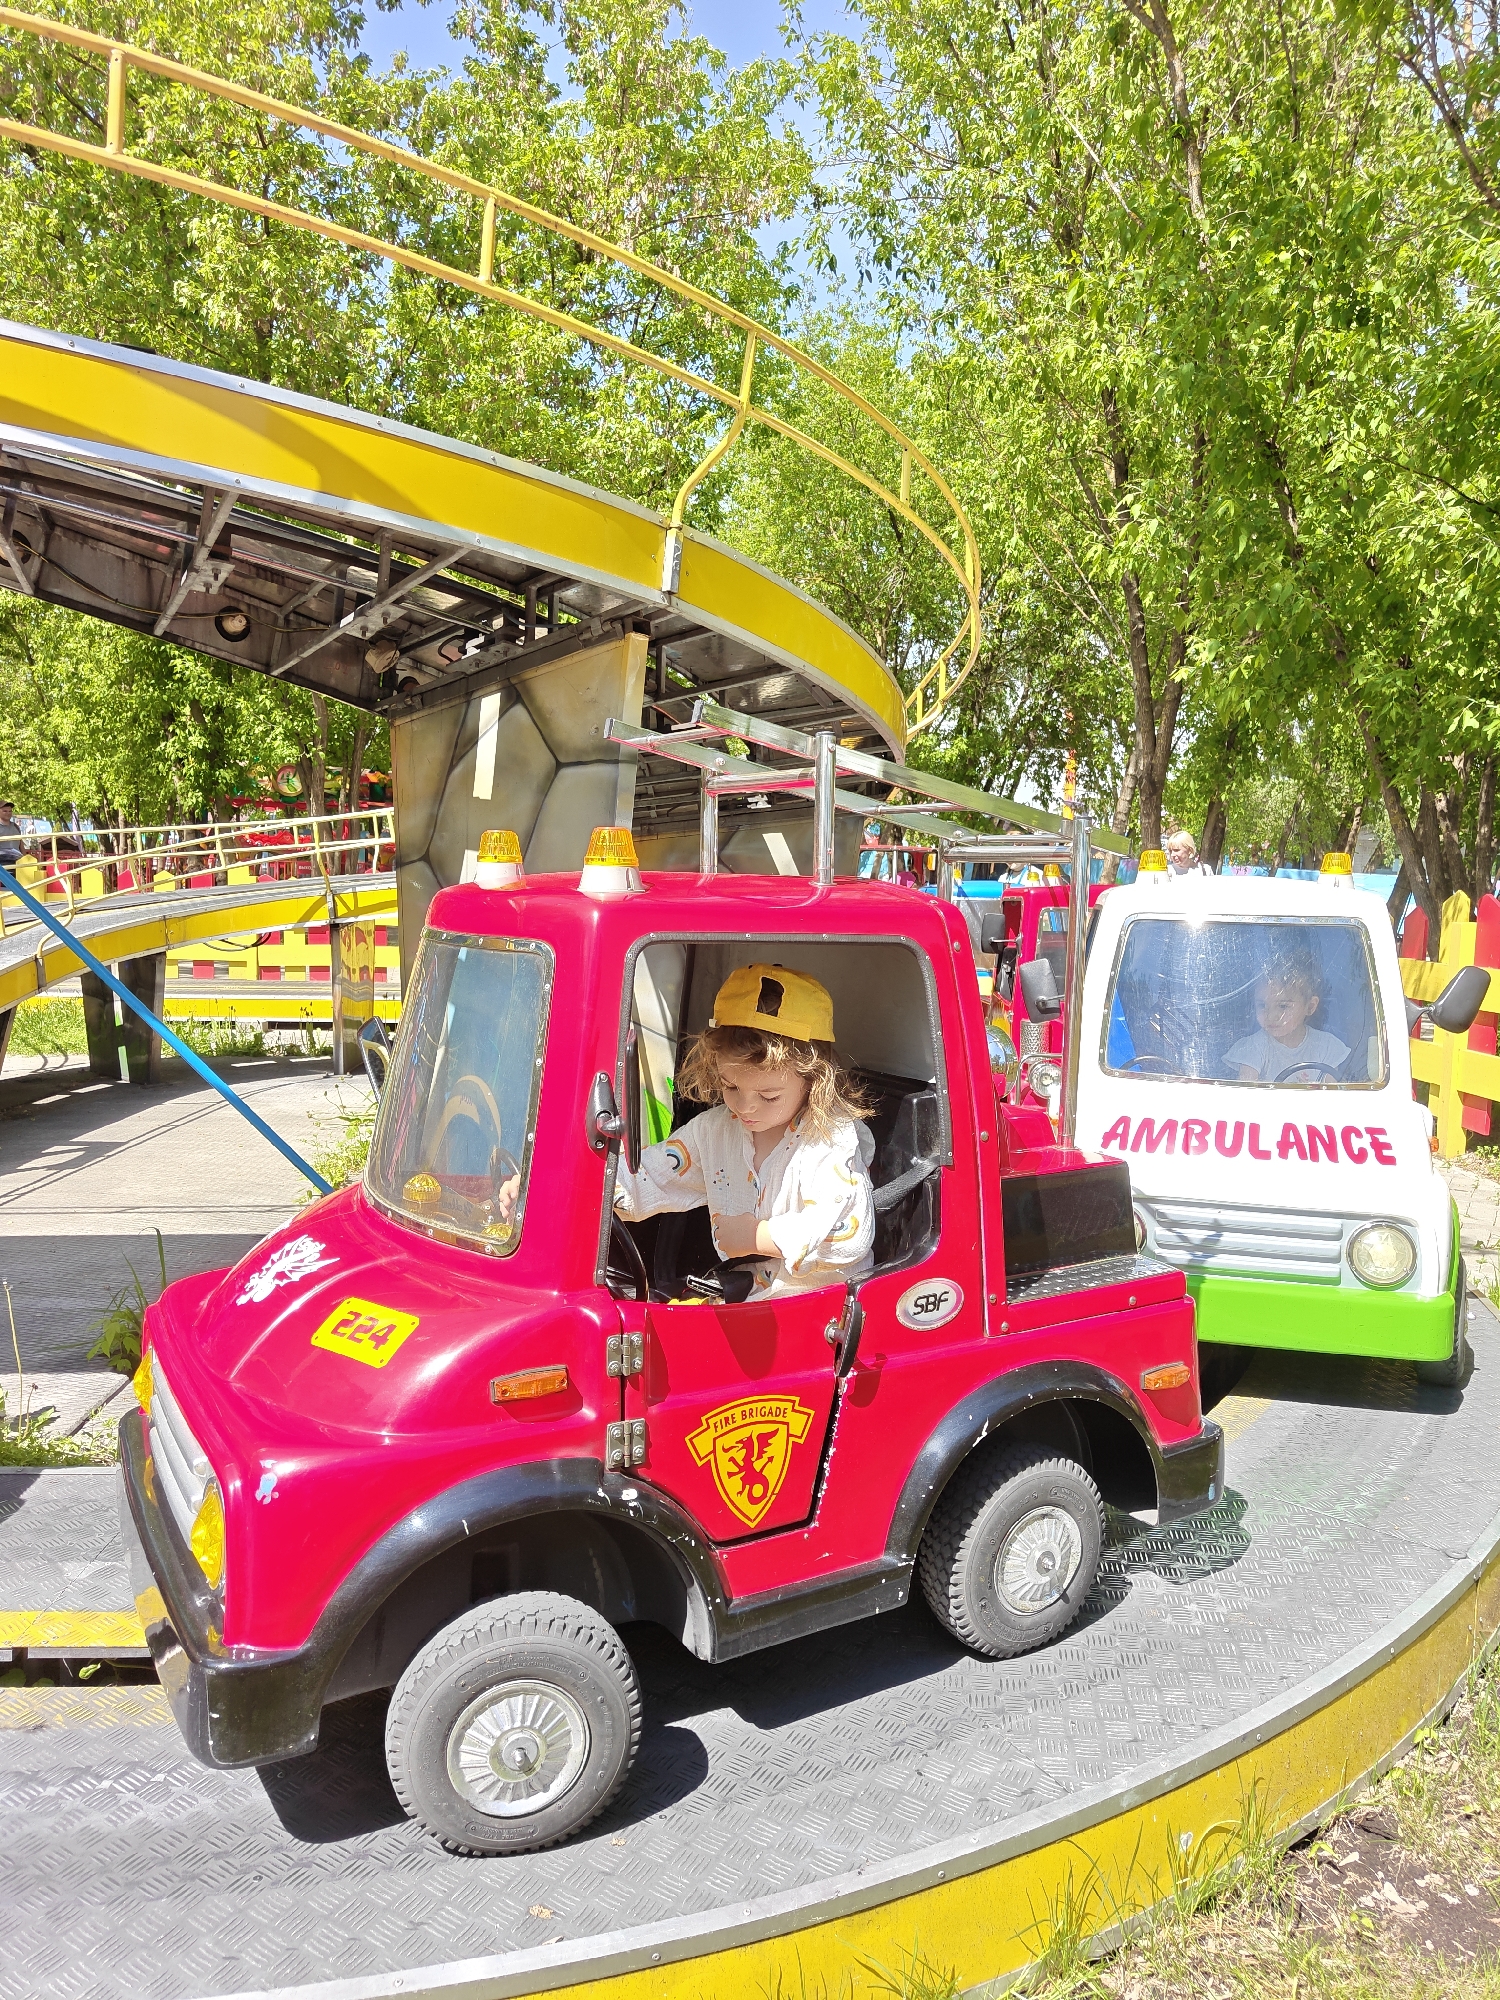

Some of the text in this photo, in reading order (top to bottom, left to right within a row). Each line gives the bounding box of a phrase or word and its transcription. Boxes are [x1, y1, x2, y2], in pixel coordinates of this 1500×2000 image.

[1101, 1115, 1397, 1166] AMBULANCE
[912, 1290, 950, 1316] SBF
[330, 1310, 397, 1351] 224
[713, 1405, 788, 1433] FIRE BRIGADE
